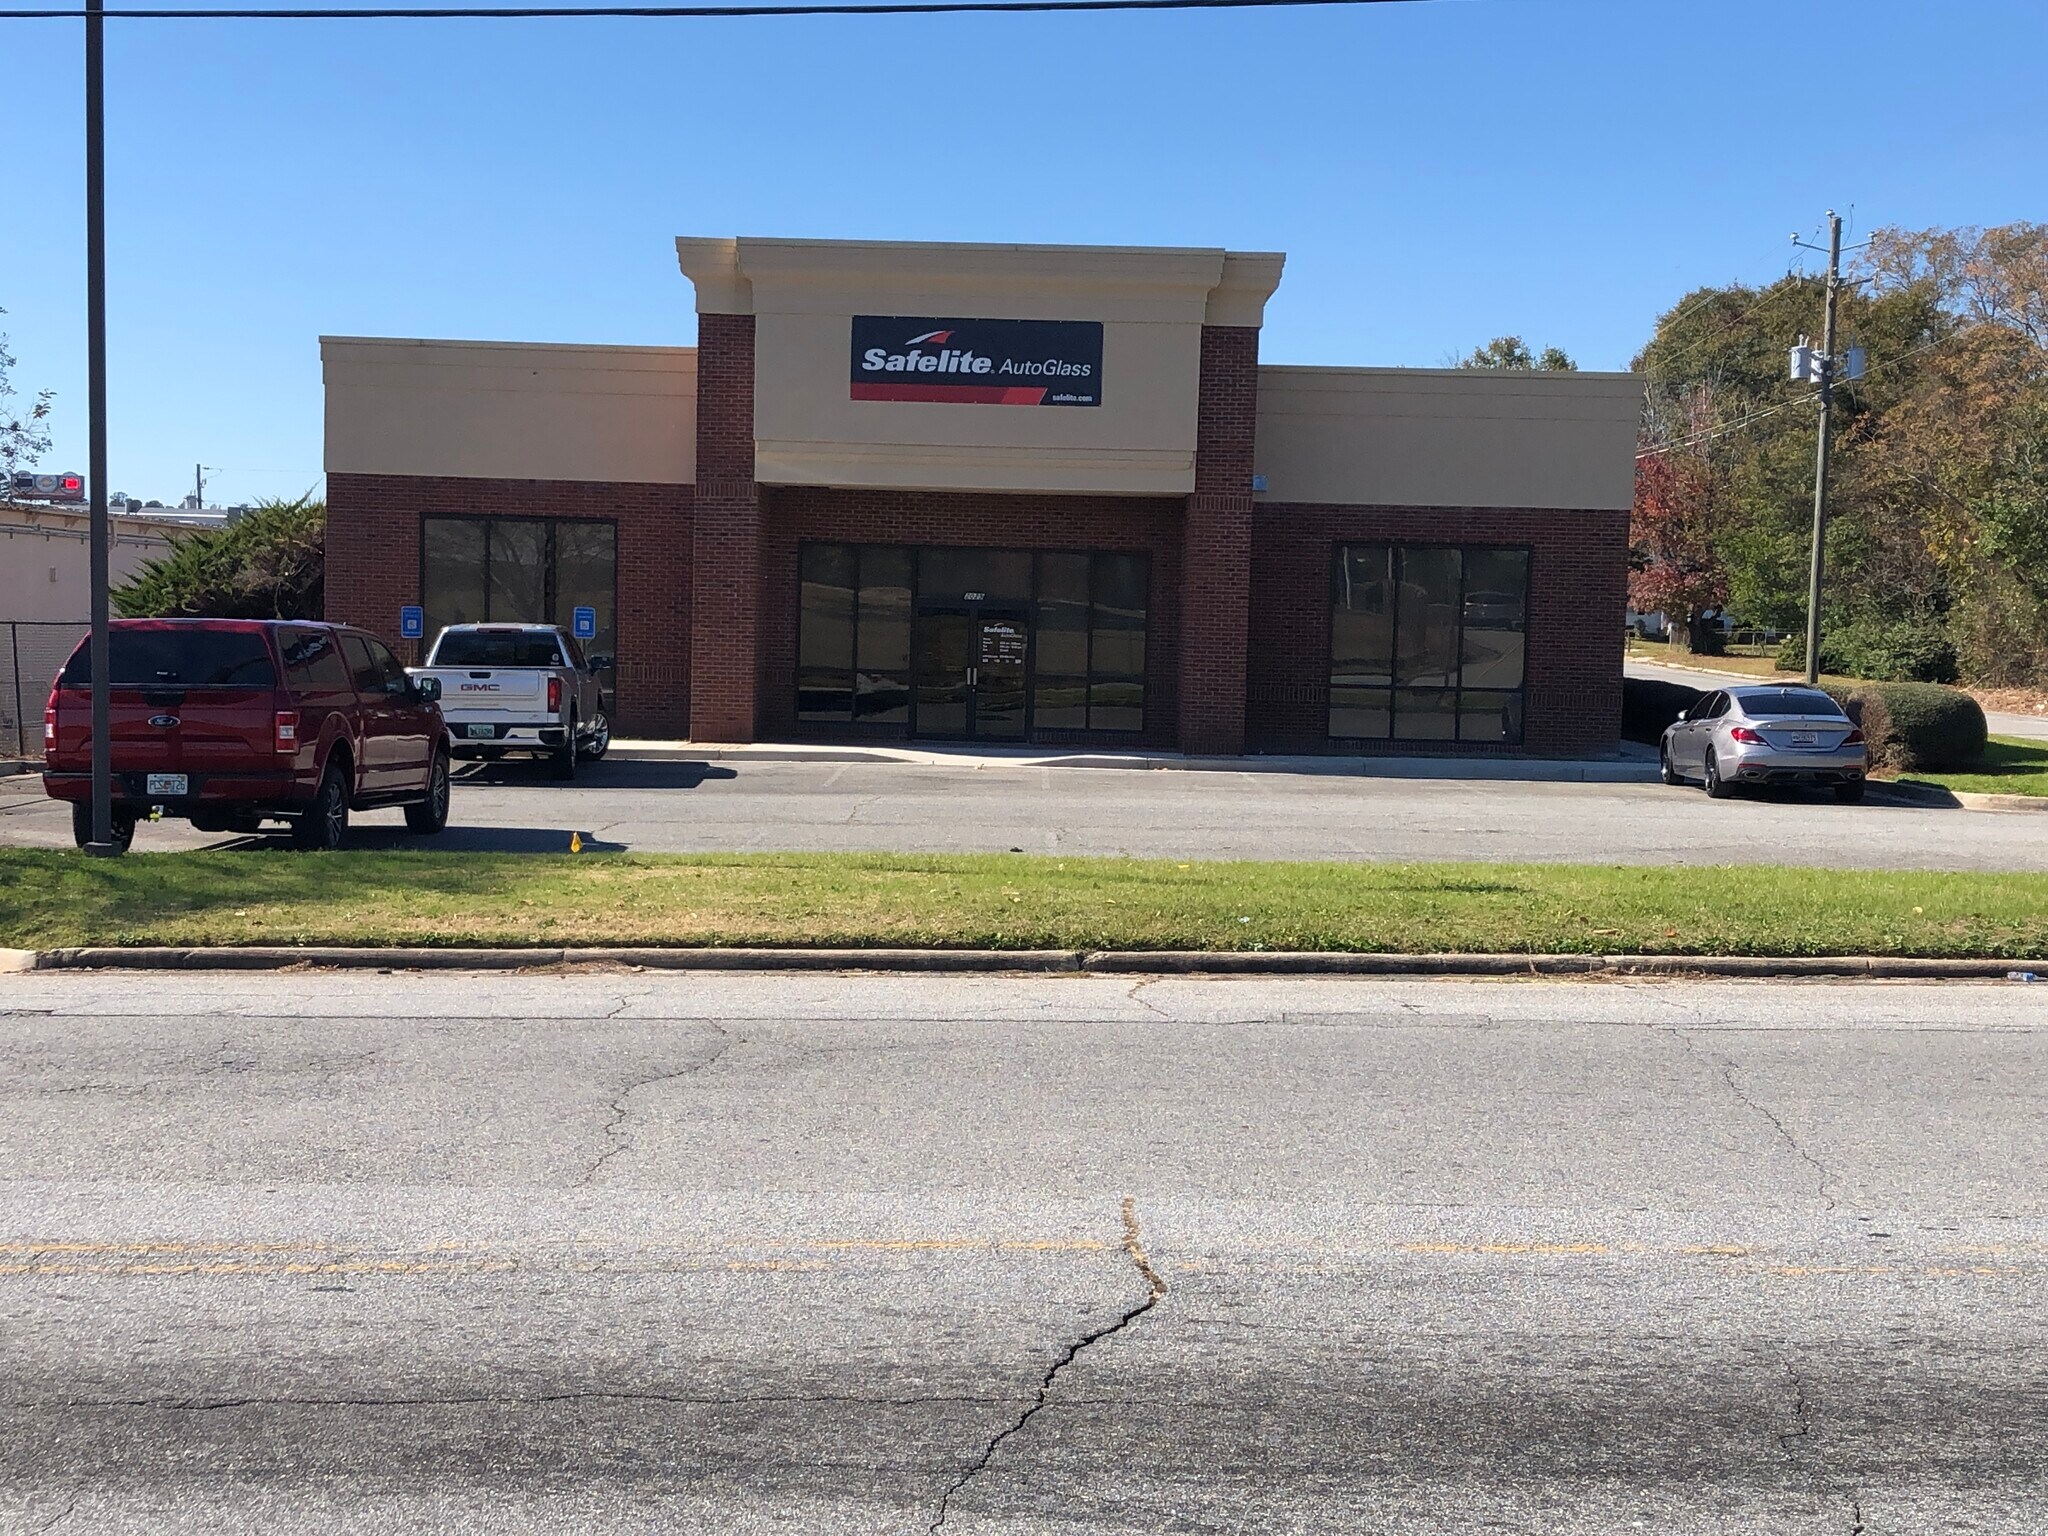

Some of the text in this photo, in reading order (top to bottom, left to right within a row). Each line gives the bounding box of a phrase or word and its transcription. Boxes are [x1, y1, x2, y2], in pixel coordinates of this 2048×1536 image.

[862, 348, 1092, 377] Safelite AutoGlass
[1052, 394, 1093, 402] safelite.com
[460, 684, 501, 692] GMC
